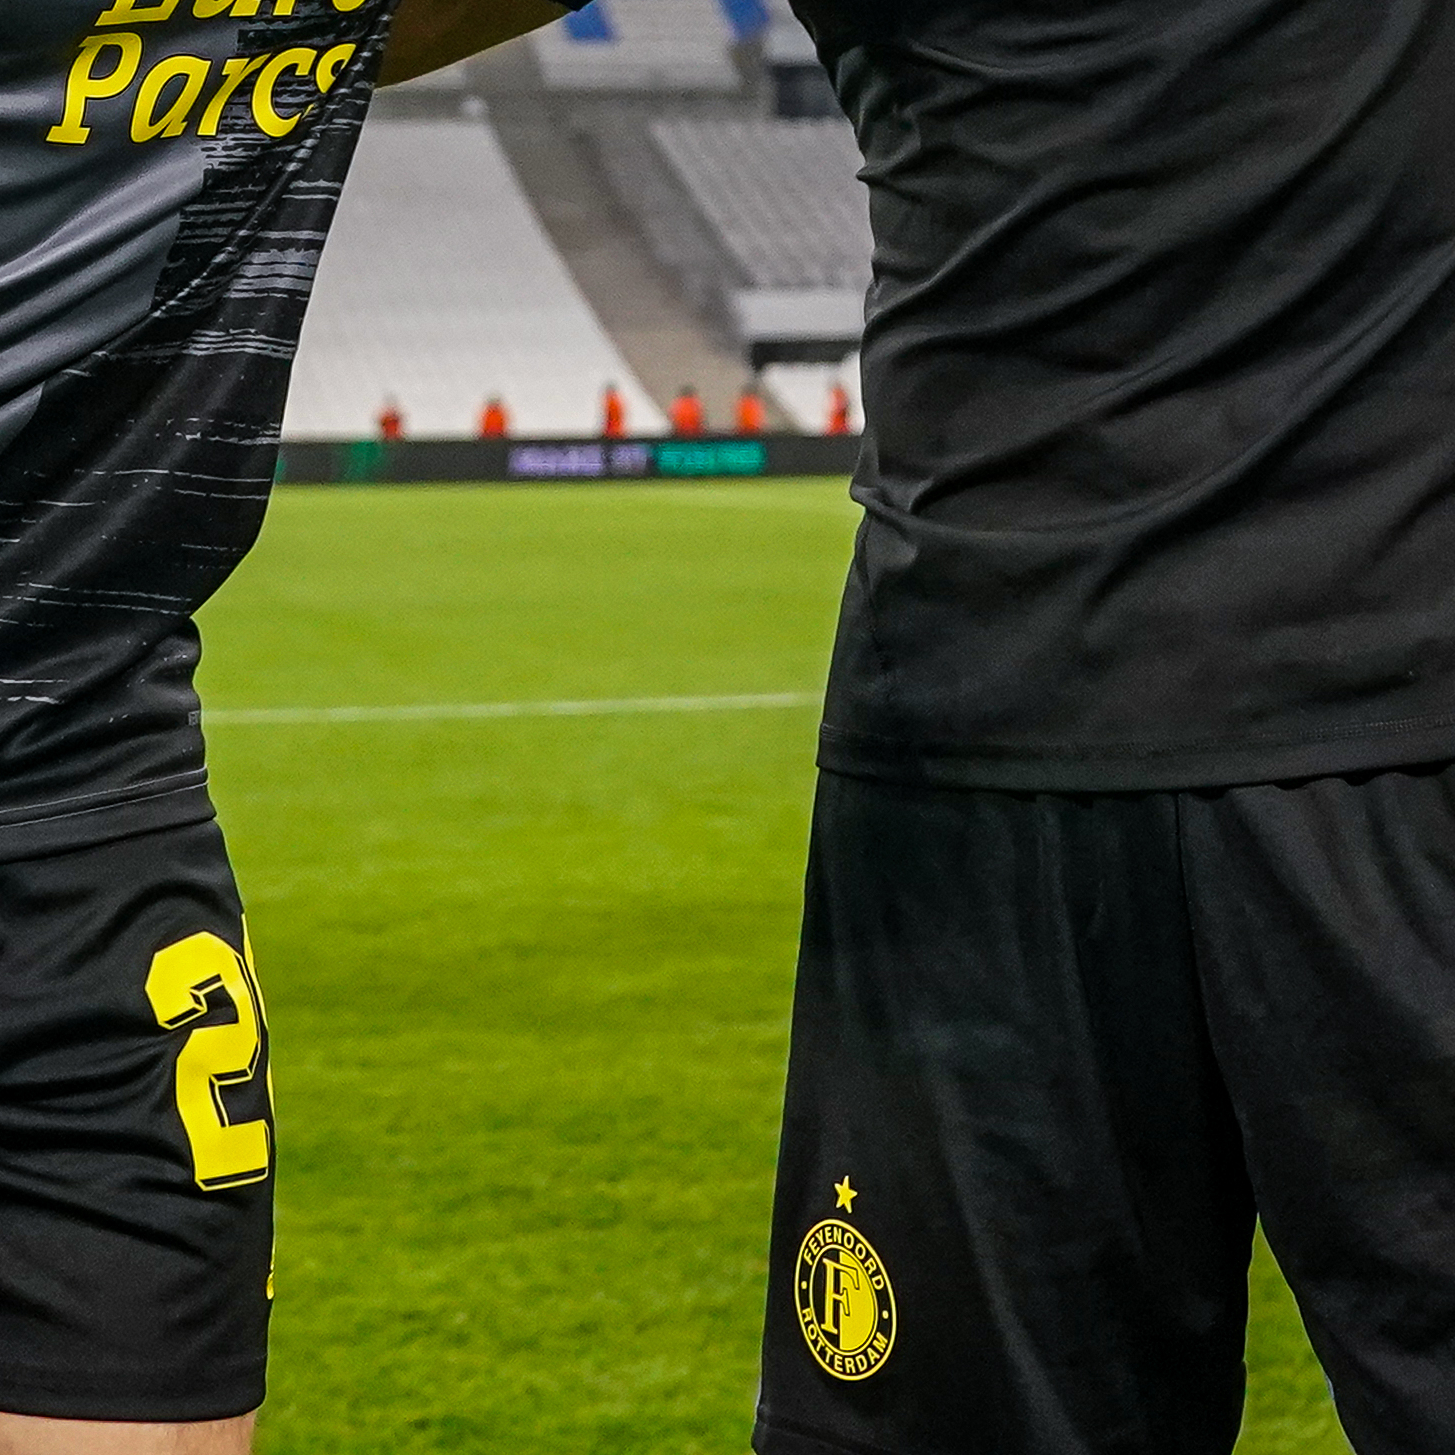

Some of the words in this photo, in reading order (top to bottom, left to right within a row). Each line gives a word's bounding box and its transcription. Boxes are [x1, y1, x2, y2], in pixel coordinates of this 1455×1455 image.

[145, 930, 270, 1192] 2
[803, 1225, 885, 1291] FEYENOORD
[802, 1307, 889, 1374] ROTTERDAM
